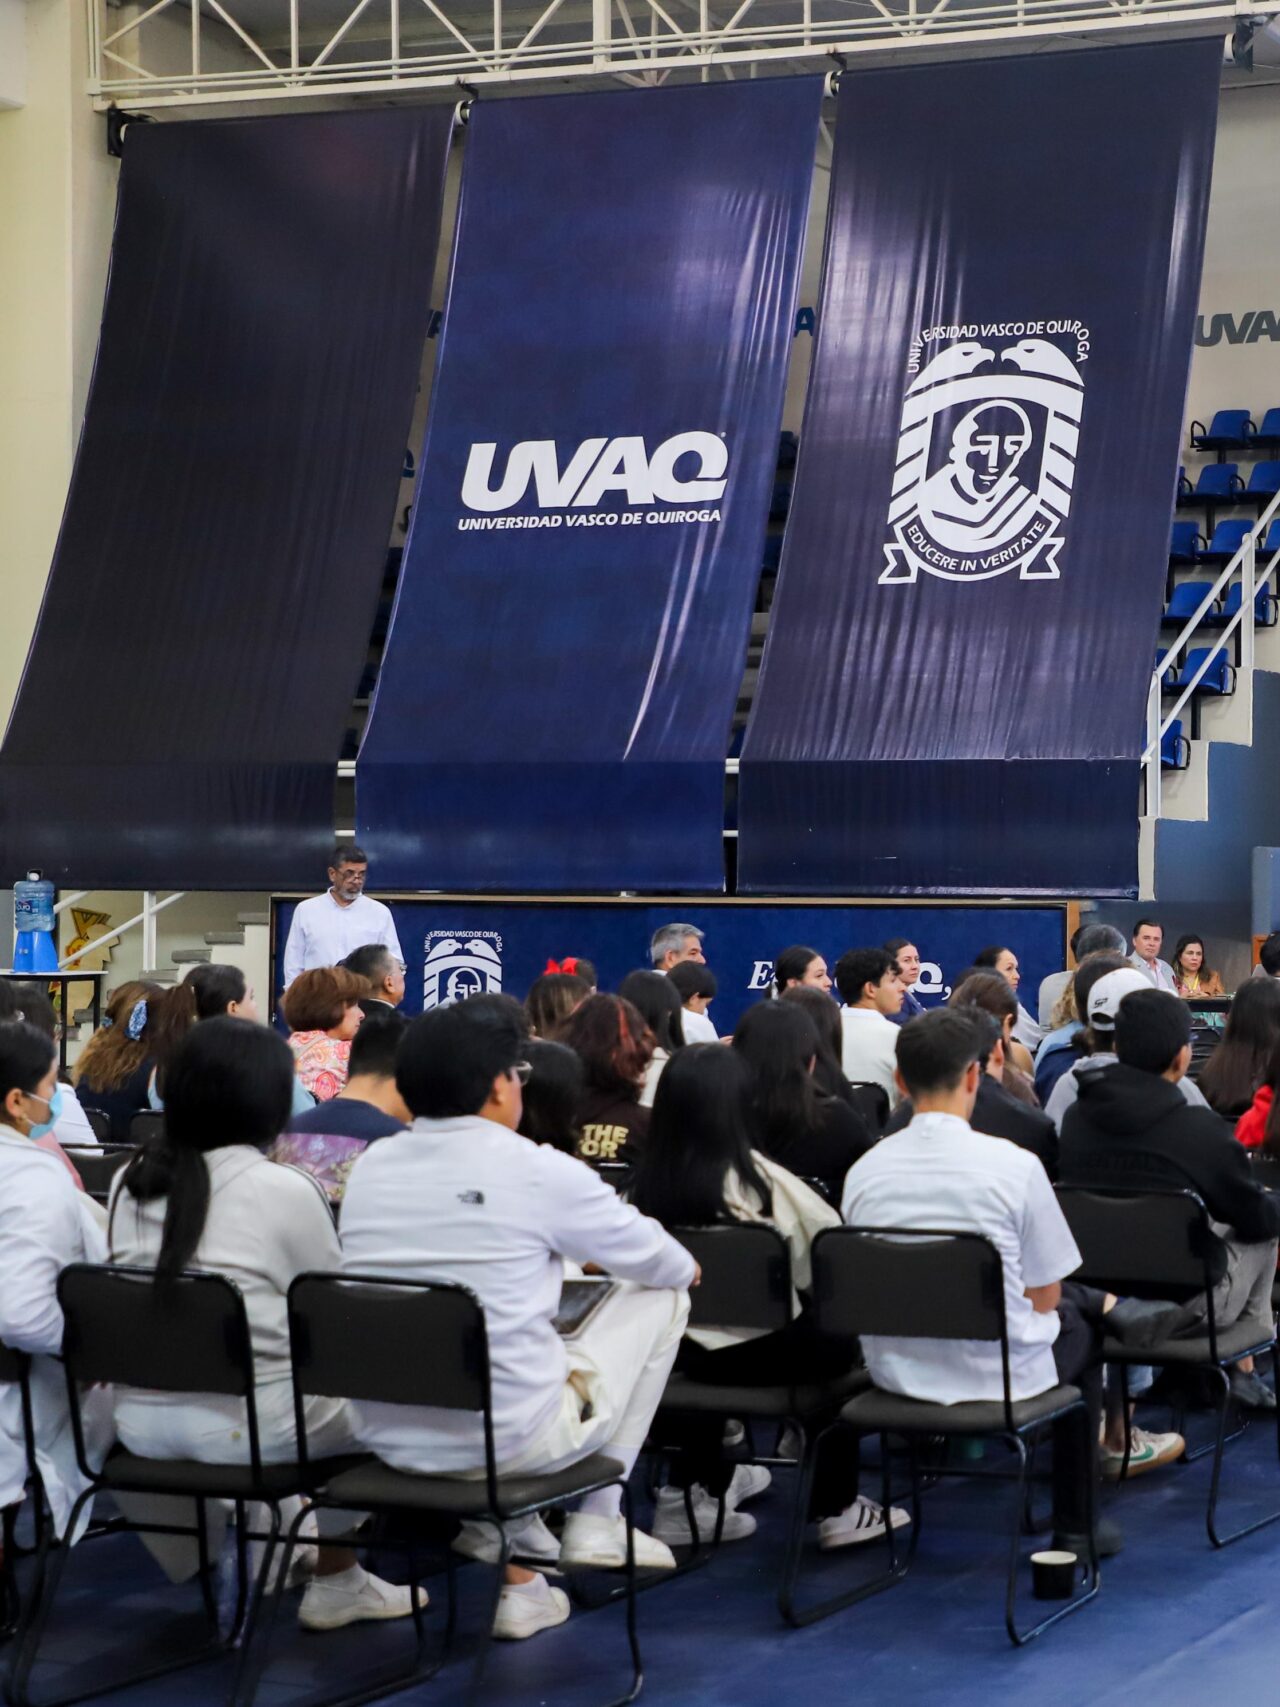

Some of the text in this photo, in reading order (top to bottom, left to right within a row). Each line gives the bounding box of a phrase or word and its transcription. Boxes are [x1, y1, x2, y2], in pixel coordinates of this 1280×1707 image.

[907, 319, 1090, 373] UNIVERSIDAD VASCO DE QUIROGA
[461, 431, 728, 512] UVAQ
[458, 509, 721, 531] UNIVERSIDAD VASCO DE QUIROGA
[907, 520, 1046, 571] EDUCERE IN VERITATE
[424, 930, 454, 953] UNIVERSIDAD
[482, 931, 502, 953] QUIROGA
[583, 1124, 629, 1145] THE
